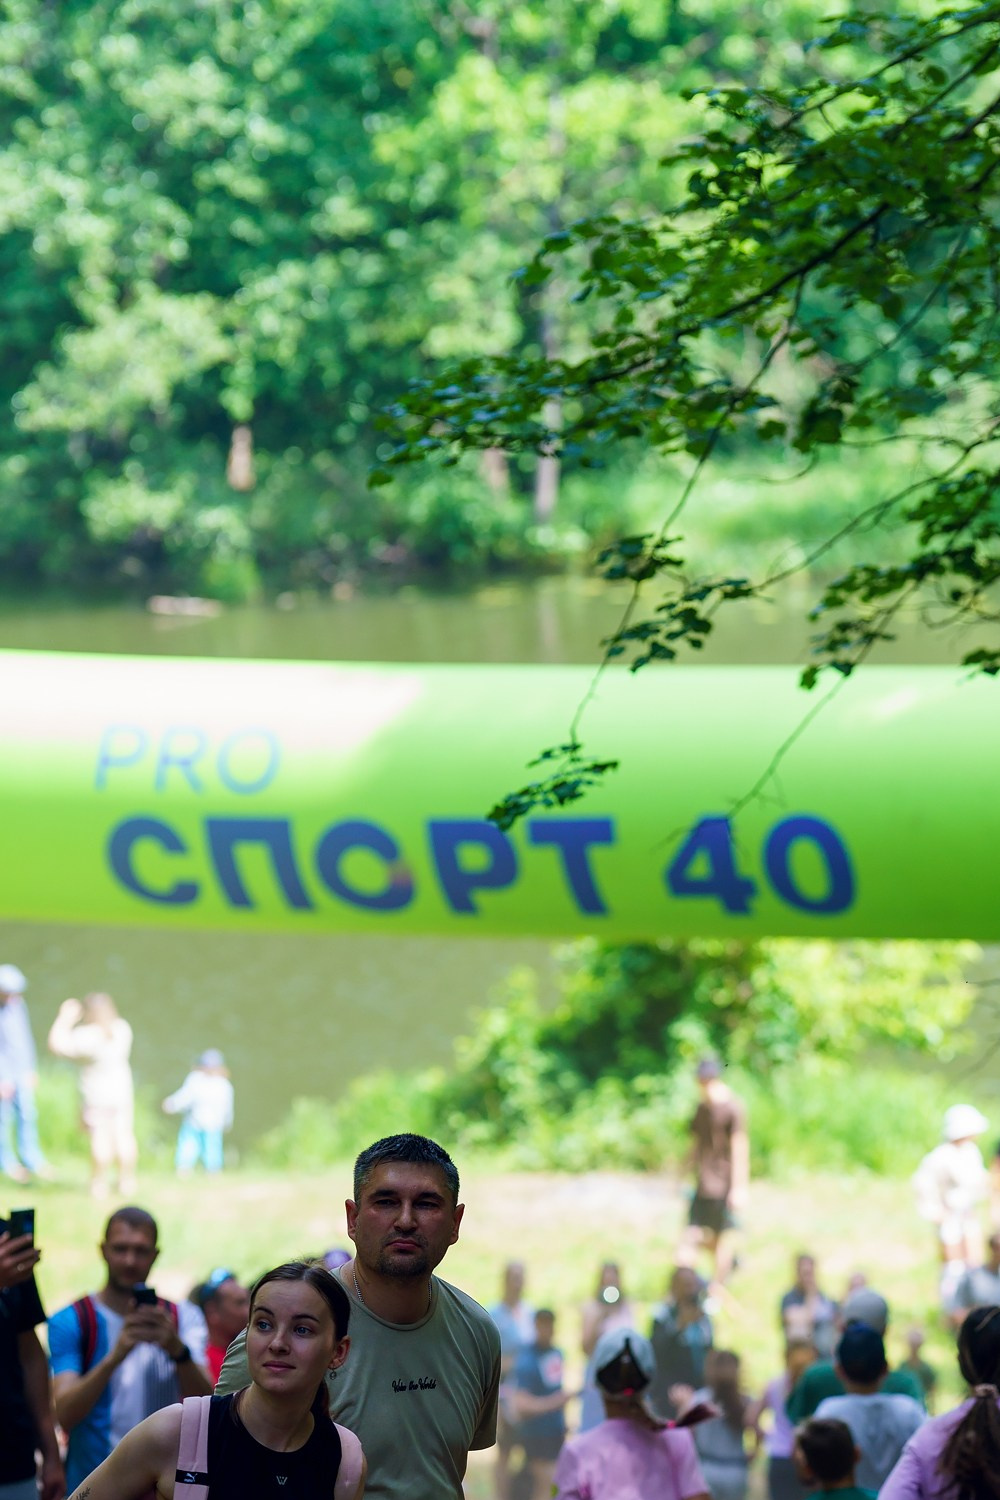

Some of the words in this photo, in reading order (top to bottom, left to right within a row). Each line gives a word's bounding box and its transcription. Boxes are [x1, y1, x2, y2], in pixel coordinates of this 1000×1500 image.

[95, 723, 280, 794] PRO
[105, 815, 615, 915] СПОРТ
[664, 813, 857, 917] 40
